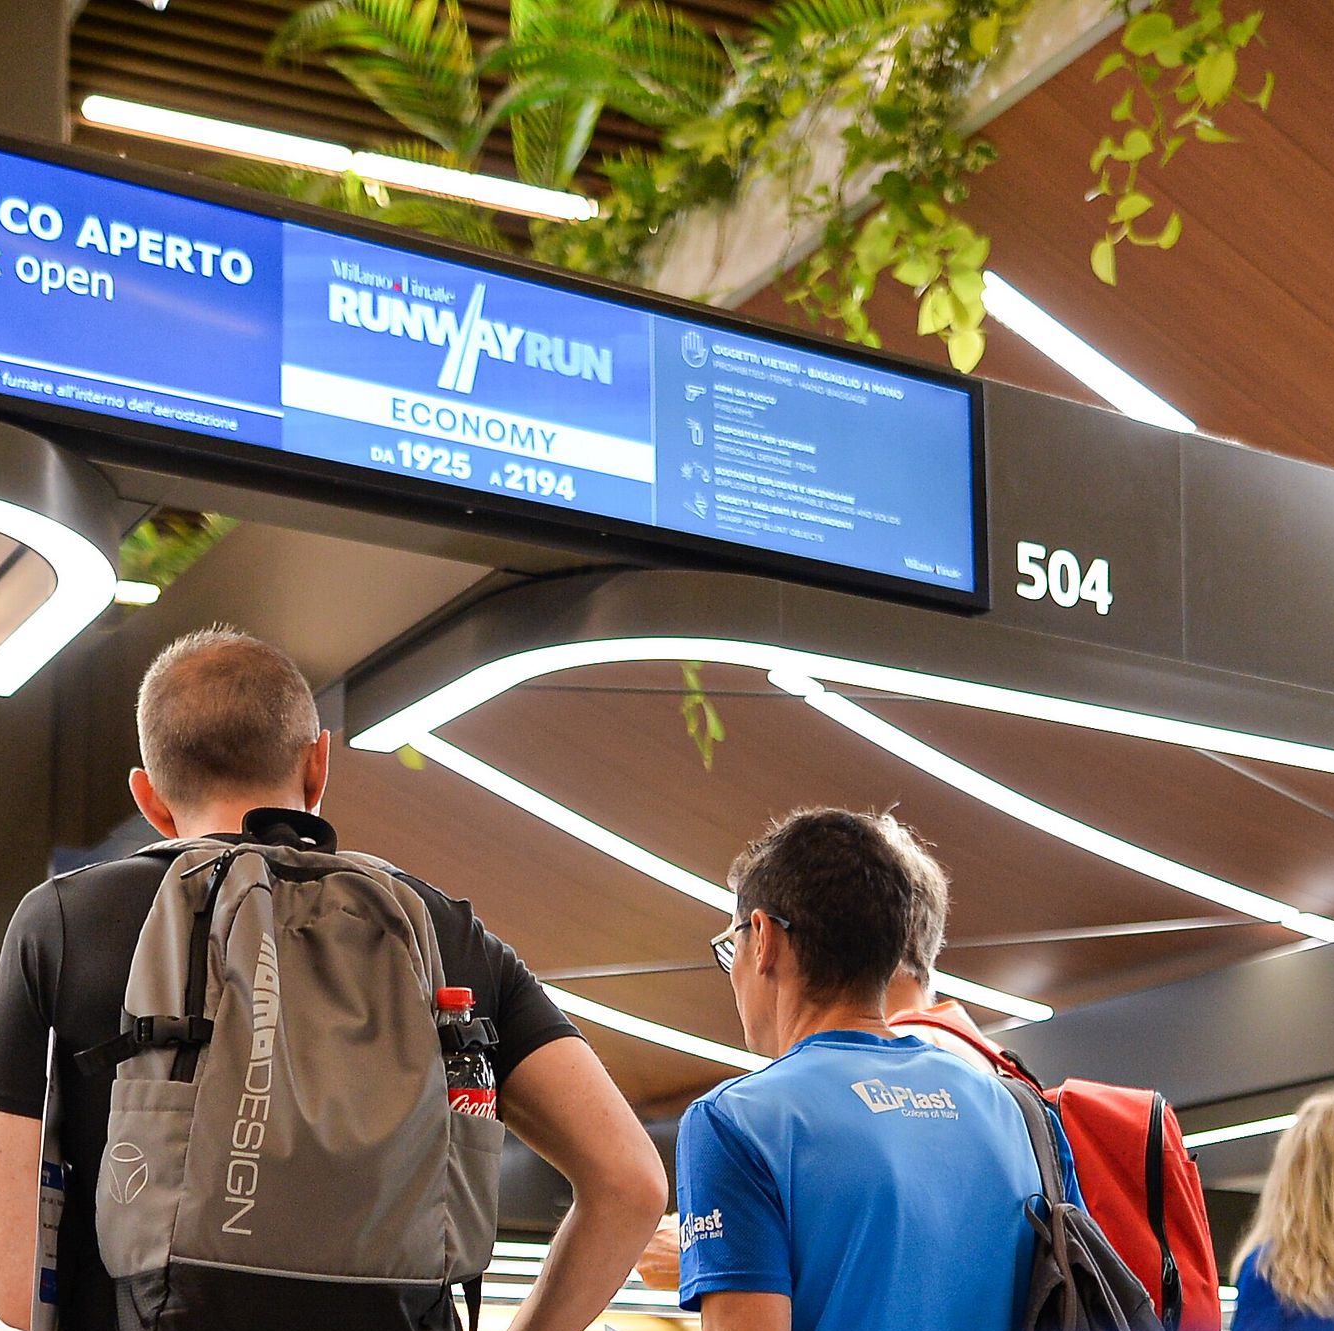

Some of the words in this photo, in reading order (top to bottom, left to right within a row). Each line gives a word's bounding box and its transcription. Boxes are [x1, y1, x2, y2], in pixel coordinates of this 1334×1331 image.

[15, 254, 114, 300] open
[76, 214, 253, 285] APERTO
[2, 369, 53, 395] fumare
[57, 382, 125, 409] all'interno
[127, 397, 239, 431] dell'aerostazione
[392, 397, 557, 455] ECONOMY
[371, 446, 396, 465] DA
[397, 440, 472, 480] 1925
[489, 472, 502, 487] A
[503, 464, 576, 501] 2194
[1016, 541, 1113, 616] 504
